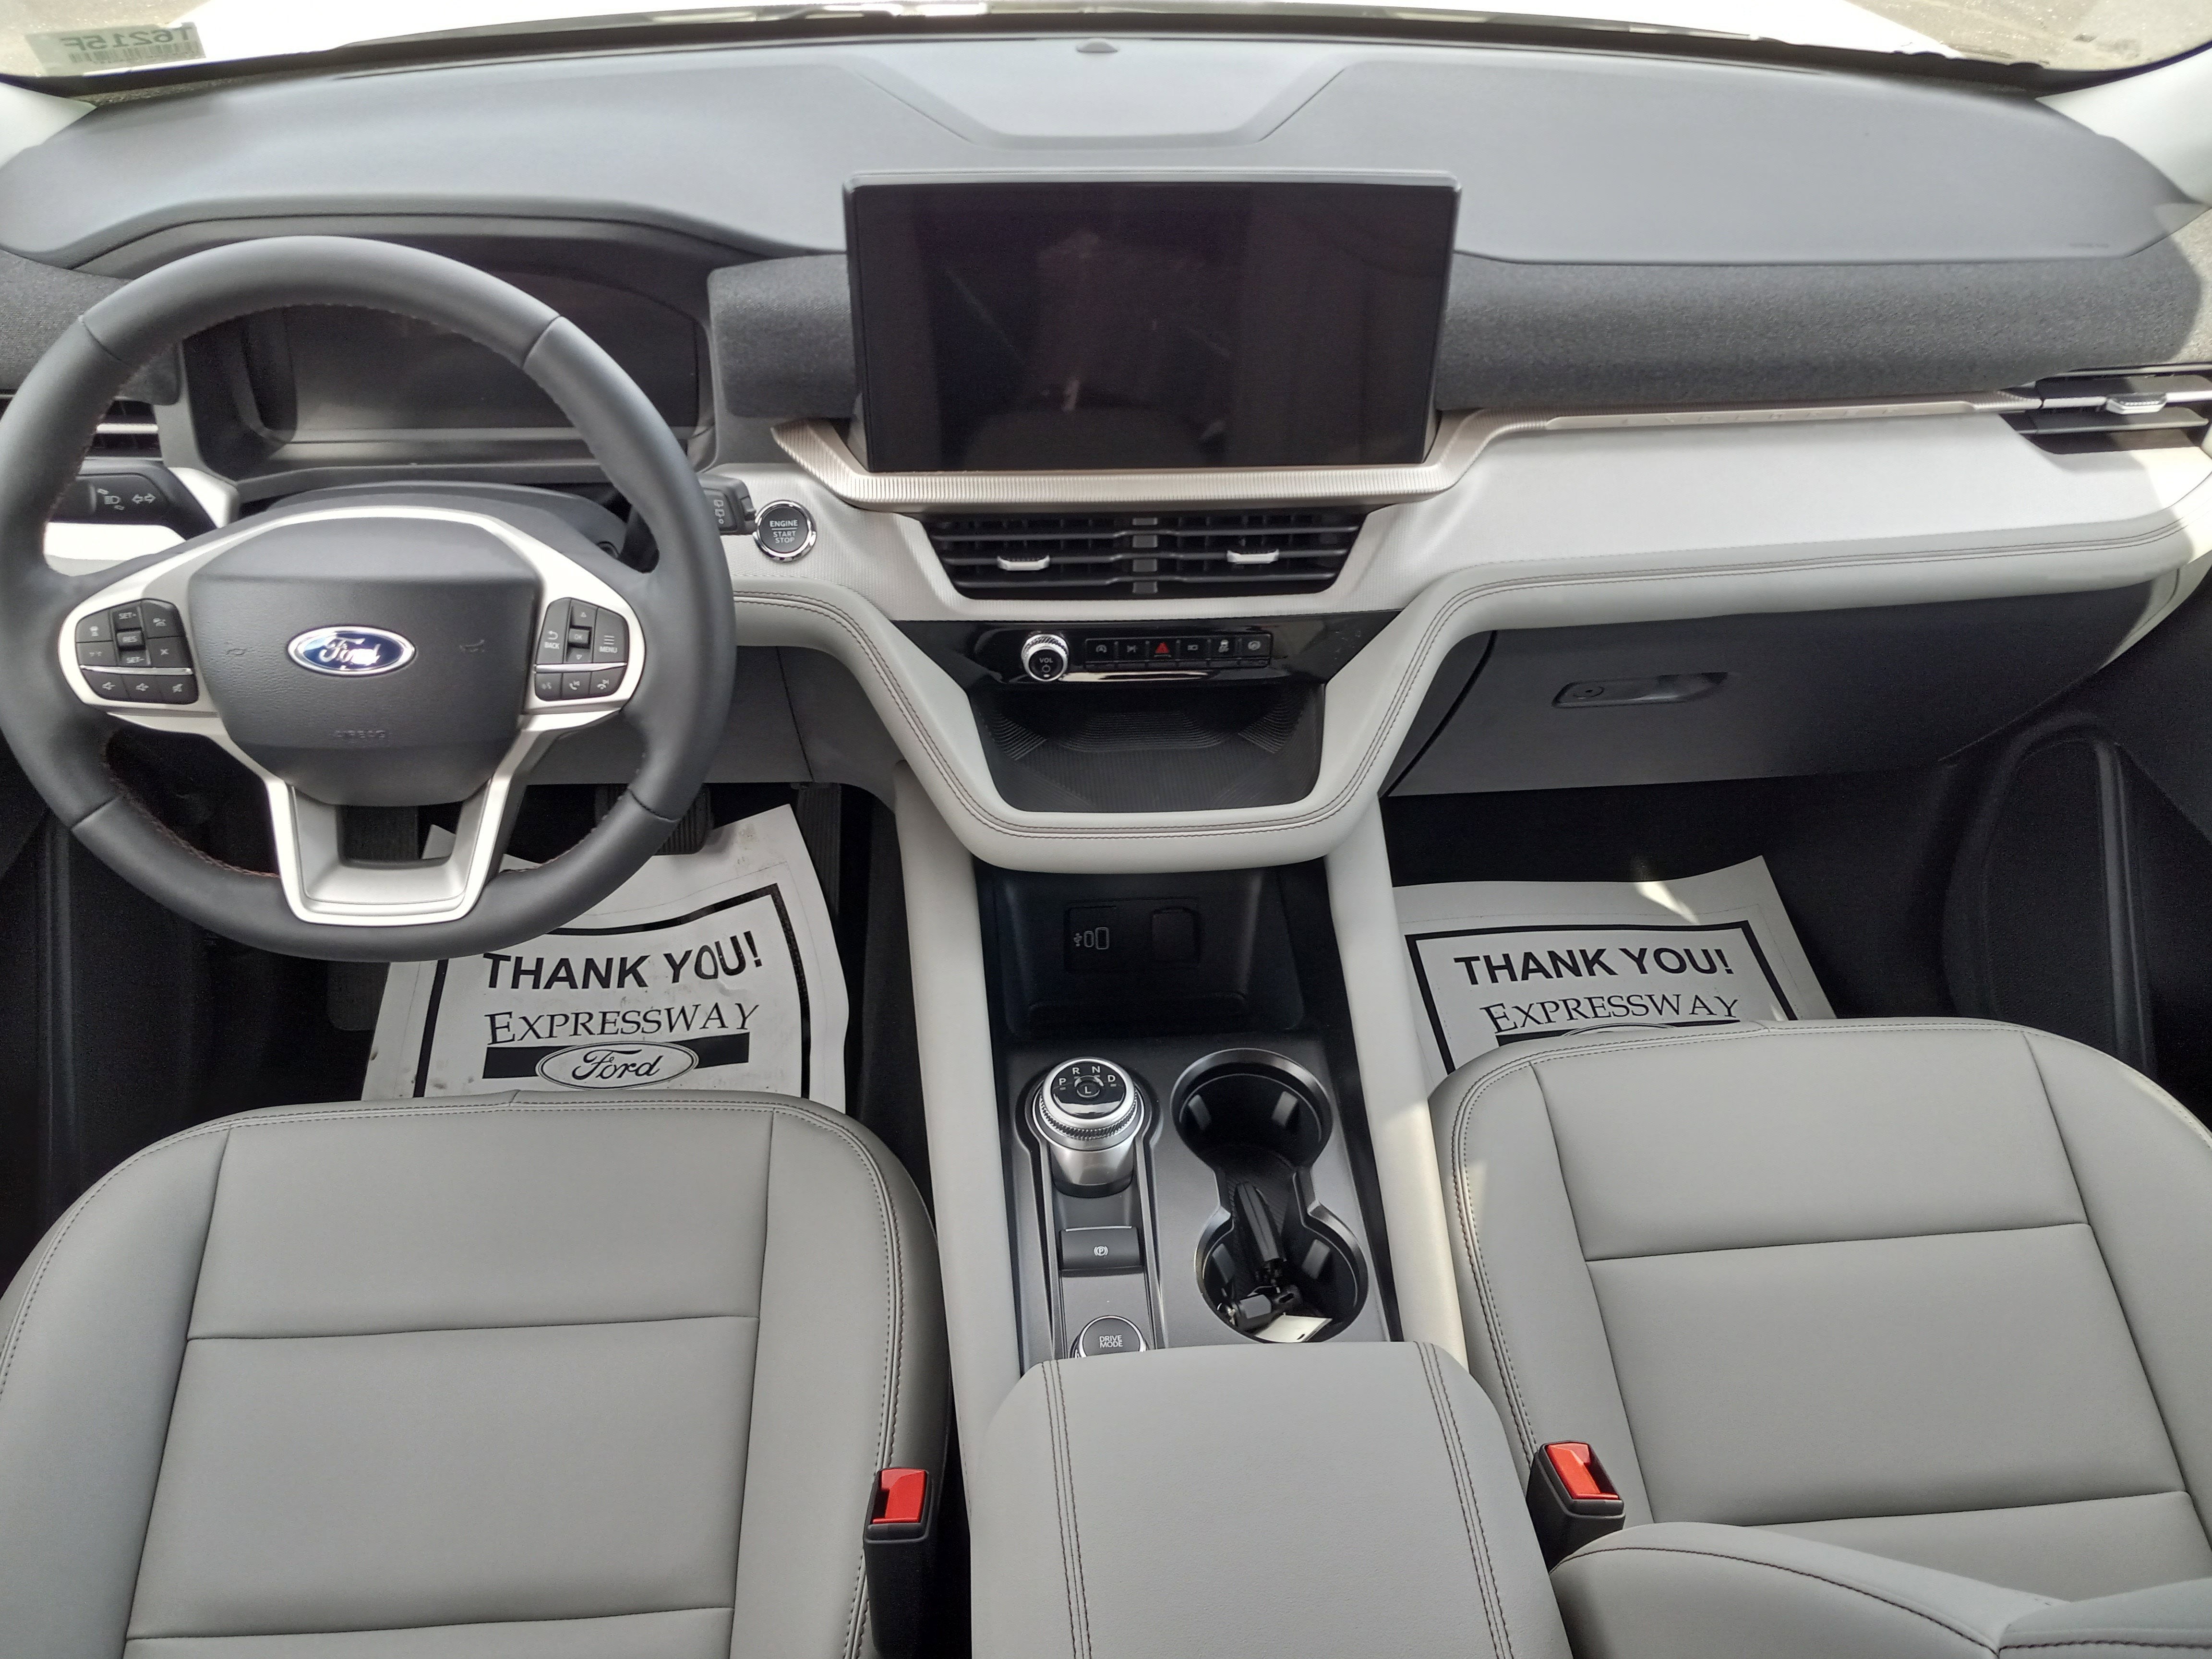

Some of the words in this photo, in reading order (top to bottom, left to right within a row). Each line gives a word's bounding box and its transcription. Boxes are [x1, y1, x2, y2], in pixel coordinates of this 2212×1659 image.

[319, 636, 381, 666] Fod
[483, 952, 649, 990] THANK
[663, 930, 763, 983] YOU!
[1453, 948, 1619, 986] THANK
[1619, 947, 1734, 975] YOU!
[484, 1002, 760, 1046] EXPRESSWAY
[1479, 993, 1740, 1034] EXPRESSWAY
[572, 1047, 664, 1081] Ford
